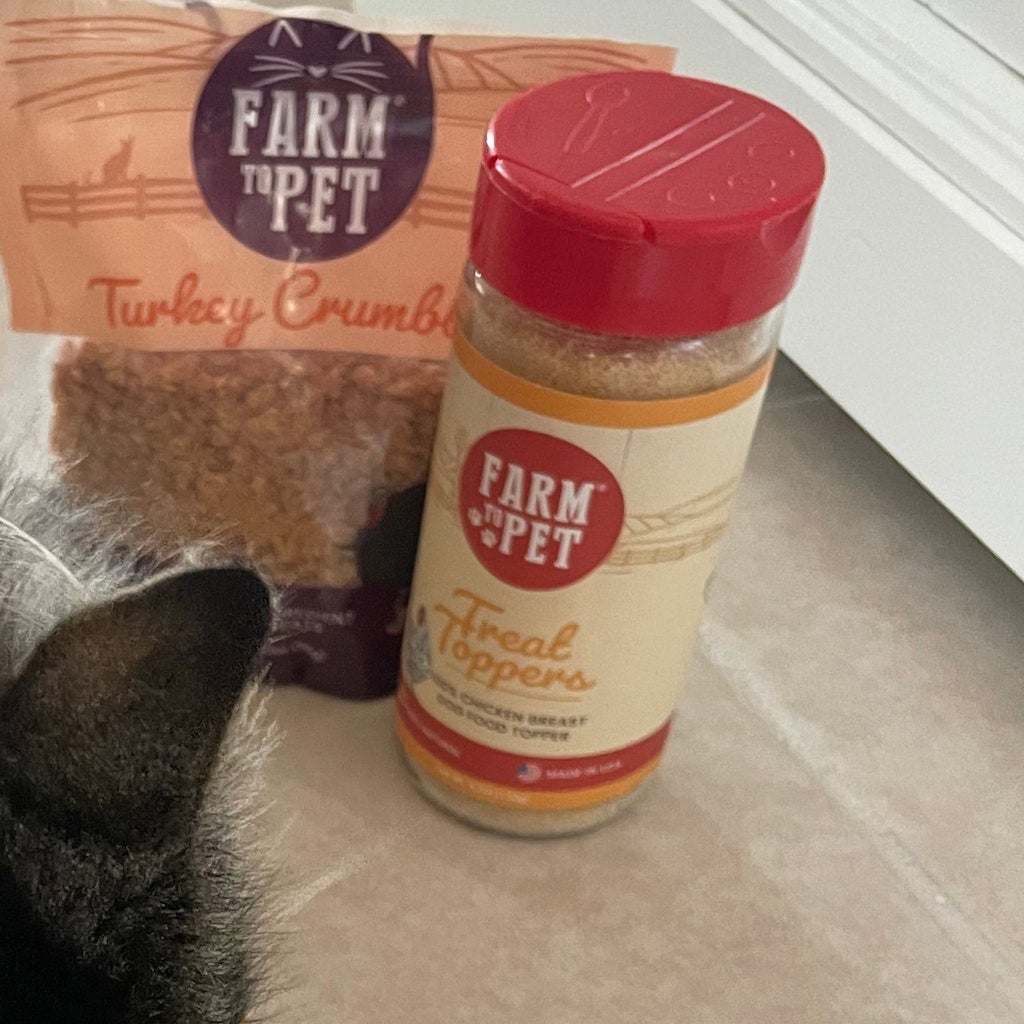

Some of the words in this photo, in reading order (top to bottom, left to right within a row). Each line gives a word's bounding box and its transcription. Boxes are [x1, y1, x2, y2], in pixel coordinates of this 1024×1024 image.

[228, 87, 389, 160] FARM
[240, 163, 272, 195] TO
[269, 164, 381, 235] PET
[87, 271, 265, 348] Turkey
[478, 451, 596, 526] FARM
[498, 511, 583, 570] PET
[434, 603, 598, 692] Toppers
[453, 587, 580, 661] Treat
